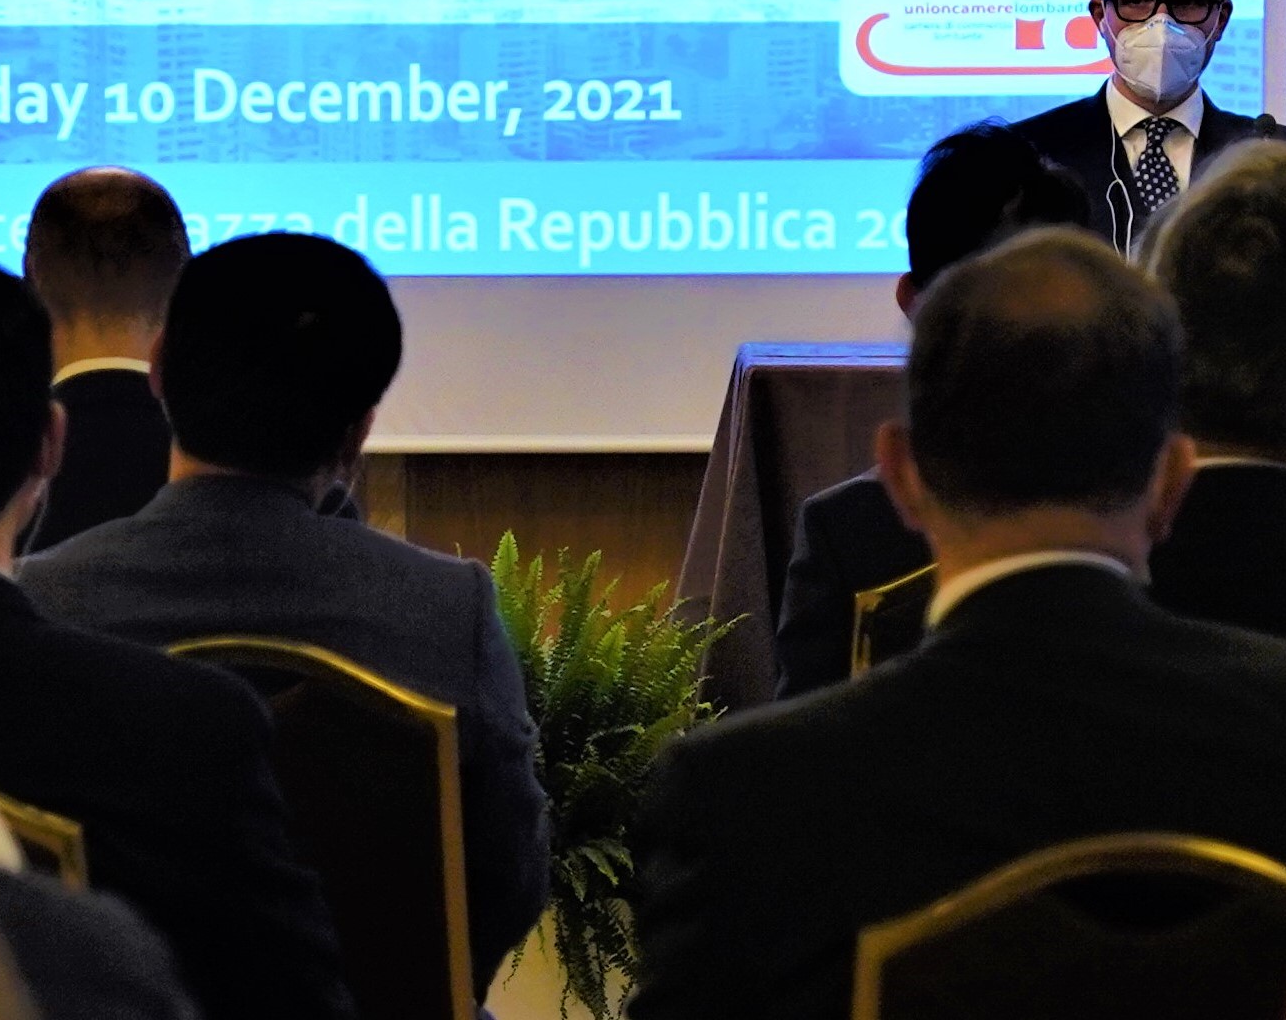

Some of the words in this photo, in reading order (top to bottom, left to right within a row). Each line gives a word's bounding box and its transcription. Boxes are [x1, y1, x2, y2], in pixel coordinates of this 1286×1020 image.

[904, 2, 1090, 15] unioncamerelombardi
[104, 81, 176, 123] 10
[194, 63, 522, 136] December,
[542, 79, 682, 121] 2021
[333, 193, 479, 253] della
[499, 192, 836, 268] Repubblica
